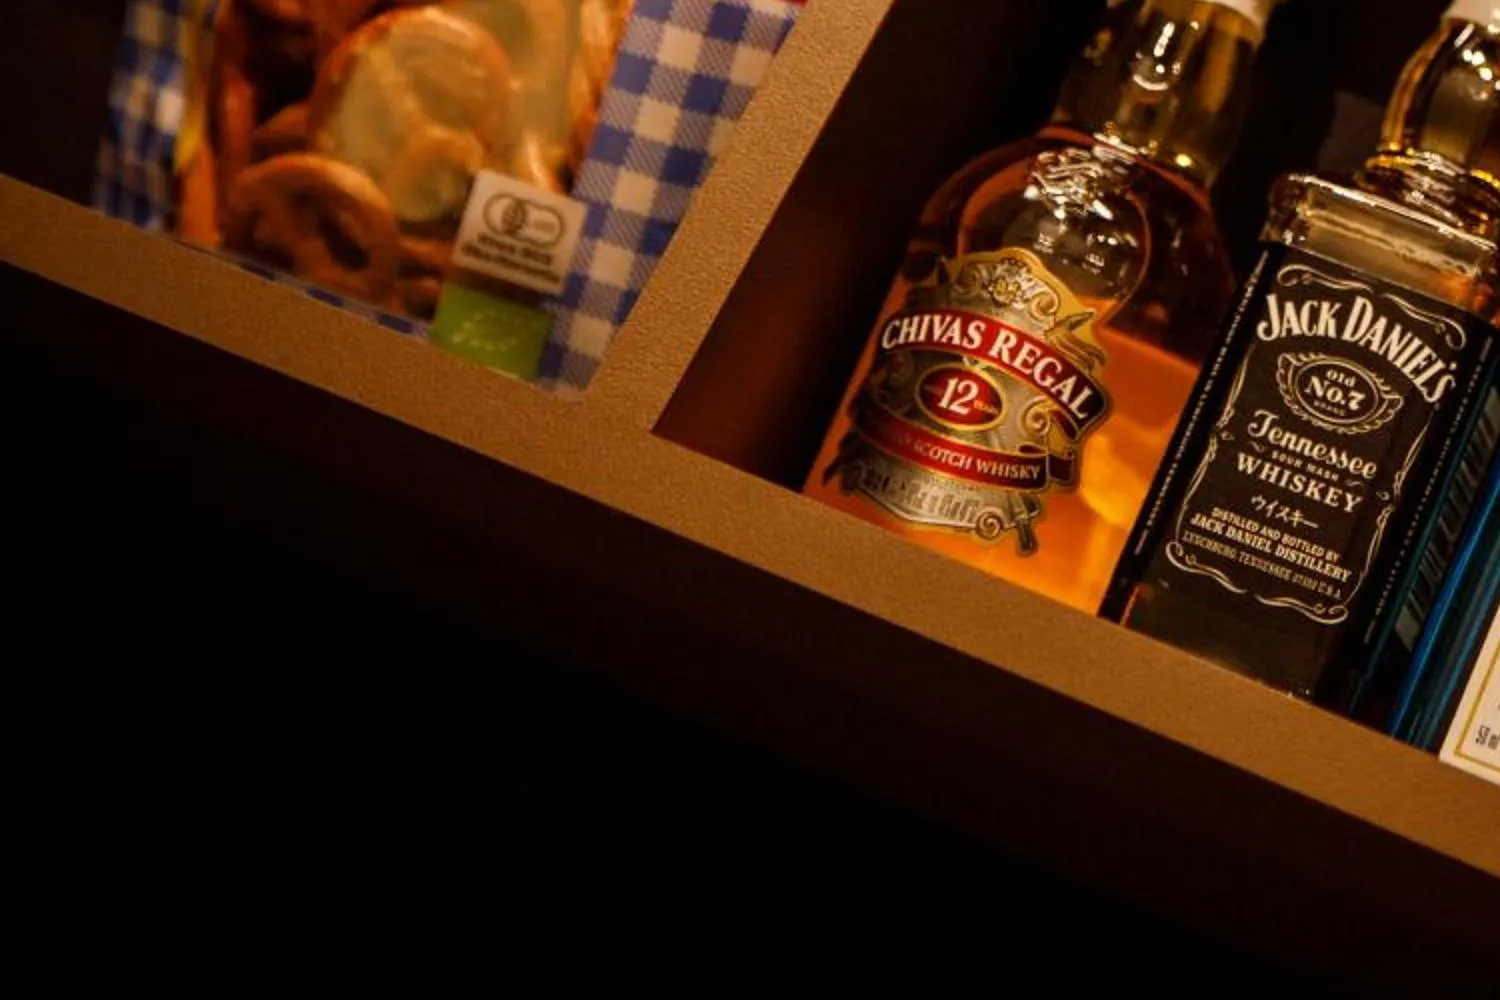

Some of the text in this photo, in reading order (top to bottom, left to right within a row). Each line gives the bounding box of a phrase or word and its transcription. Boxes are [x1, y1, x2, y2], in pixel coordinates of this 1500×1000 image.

[881, 313, 1090, 420] CHIVAS REGAL
[1256, 293, 1341, 341] JACK
[1342, 295, 1456, 403] DANIEL'S
[937, 376, 980, 415] 12
[975, 457, 1042, 480] WHISKY
[1247, 408, 1377, 480] Tennessee
[1237, 452, 1363, 513] WHISKEY
[1250, 494, 1320, 528] ウイスキー
[1189, 512, 1227, 535] JACK
[1225, 526, 1273, 553] DANIEL
[1274, 543, 1353, 583] DISTILLERY
